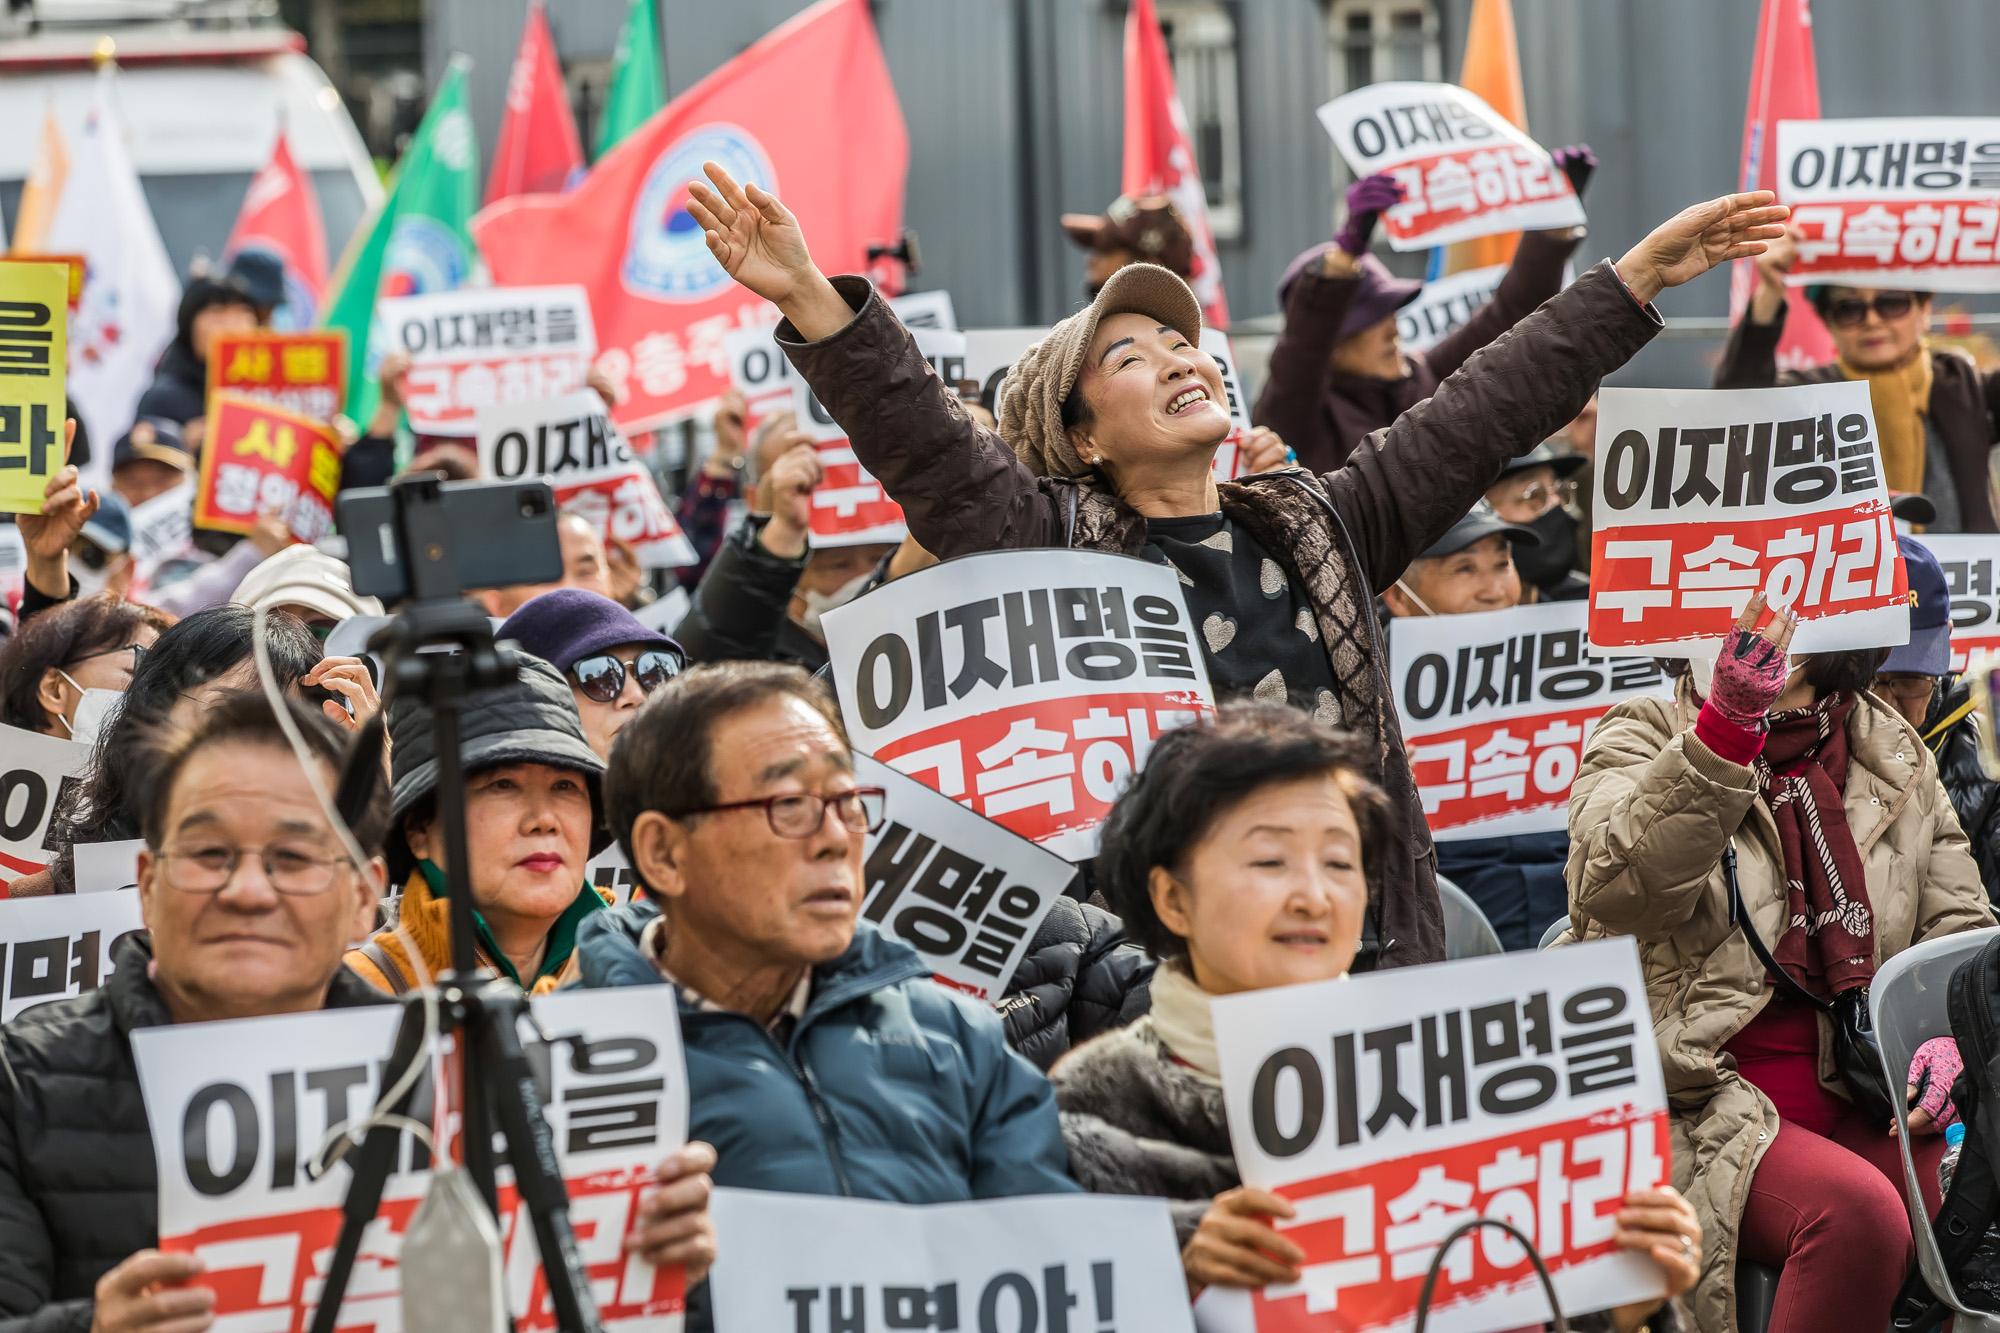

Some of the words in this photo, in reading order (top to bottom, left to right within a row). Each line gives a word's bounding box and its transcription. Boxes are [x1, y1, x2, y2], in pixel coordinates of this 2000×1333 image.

[402, 305, 577, 353] 이재명을
[1603, 413, 1879, 510] 이재명을
[1595, 514, 1899, 622] 구속하라
[856, 586, 1197, 730] 이재명을
[1251, 985, 1637, 1158] 이재명을
[1263, 1120, 1665, 1314] 구속하라
